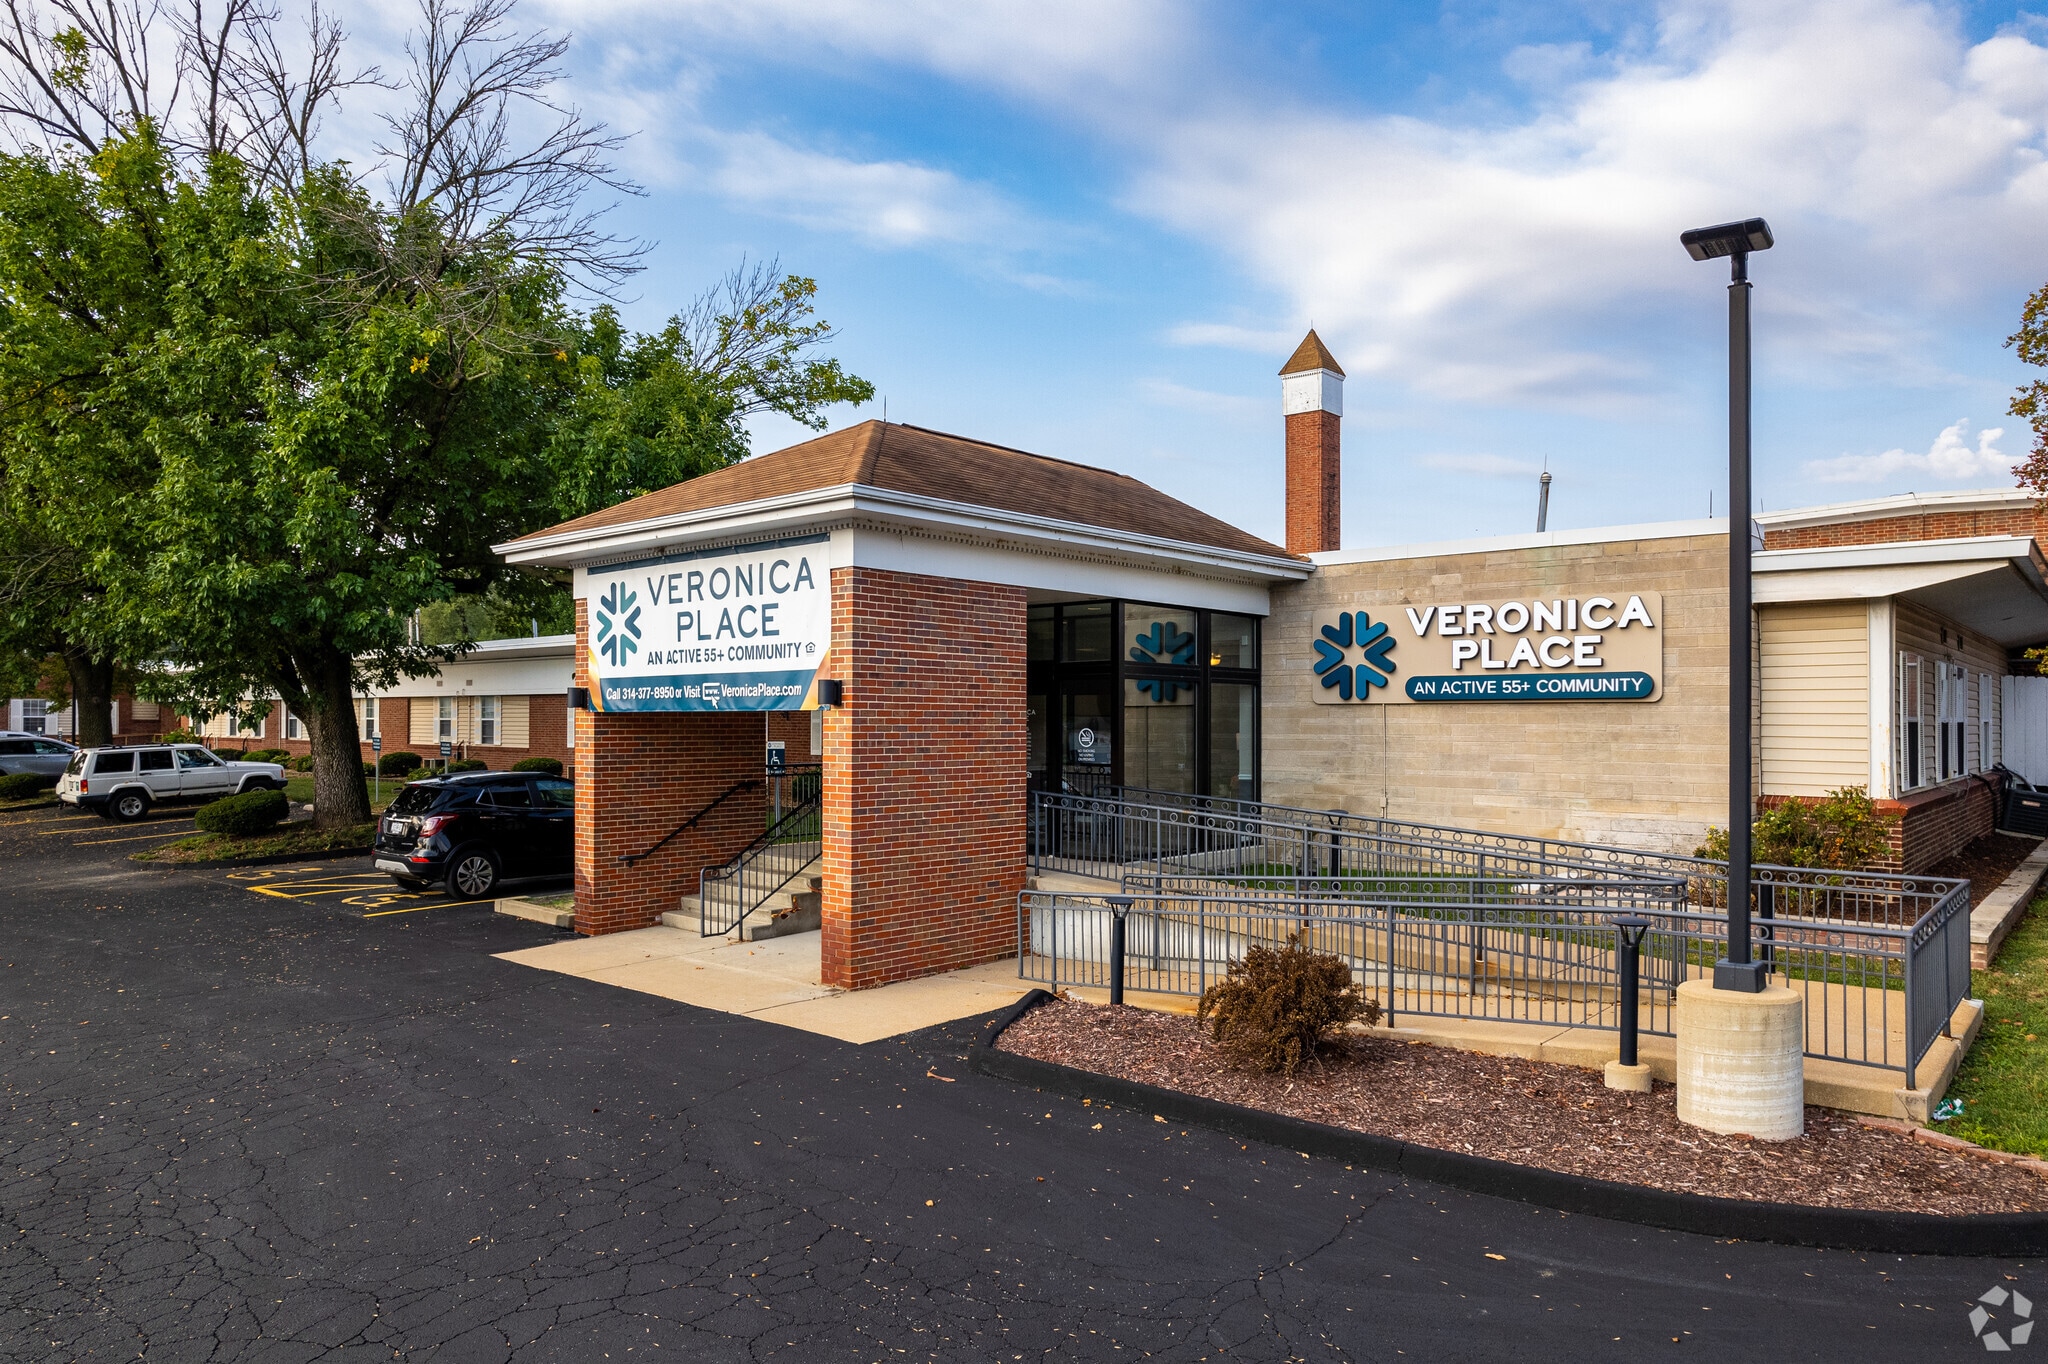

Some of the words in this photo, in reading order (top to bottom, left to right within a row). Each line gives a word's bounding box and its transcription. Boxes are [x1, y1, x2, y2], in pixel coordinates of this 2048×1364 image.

[647, 557, 815, 606] VERONICA
[677, 603, 780, 642] PLACE
[1405, 595, 1654, 637] VERONICA
[647, 651, 663, 665] AN
[666, 649, 701, 665] ACTIVE
[704, 648, 725, 662] 55+
[727, 642, 802, 661] COMMUNITY
[1452, 635, 1603, 671] PLACE
[606, 687, 621, 700] Call
[622, 686, 674, 699] 314-377-8950
[675, 688, 683, 698] or
[683, 685, 701, 698] Visit
[721, 682, 802, 697] VeronicaPlace.com
[1413, 681, 1436, 694] AN
[1440, 680, 1497, 694] ACTIVE
[1502, 679, 1531, 693] 55+
[1536, 677, 1644, 693] COMMUNITY
